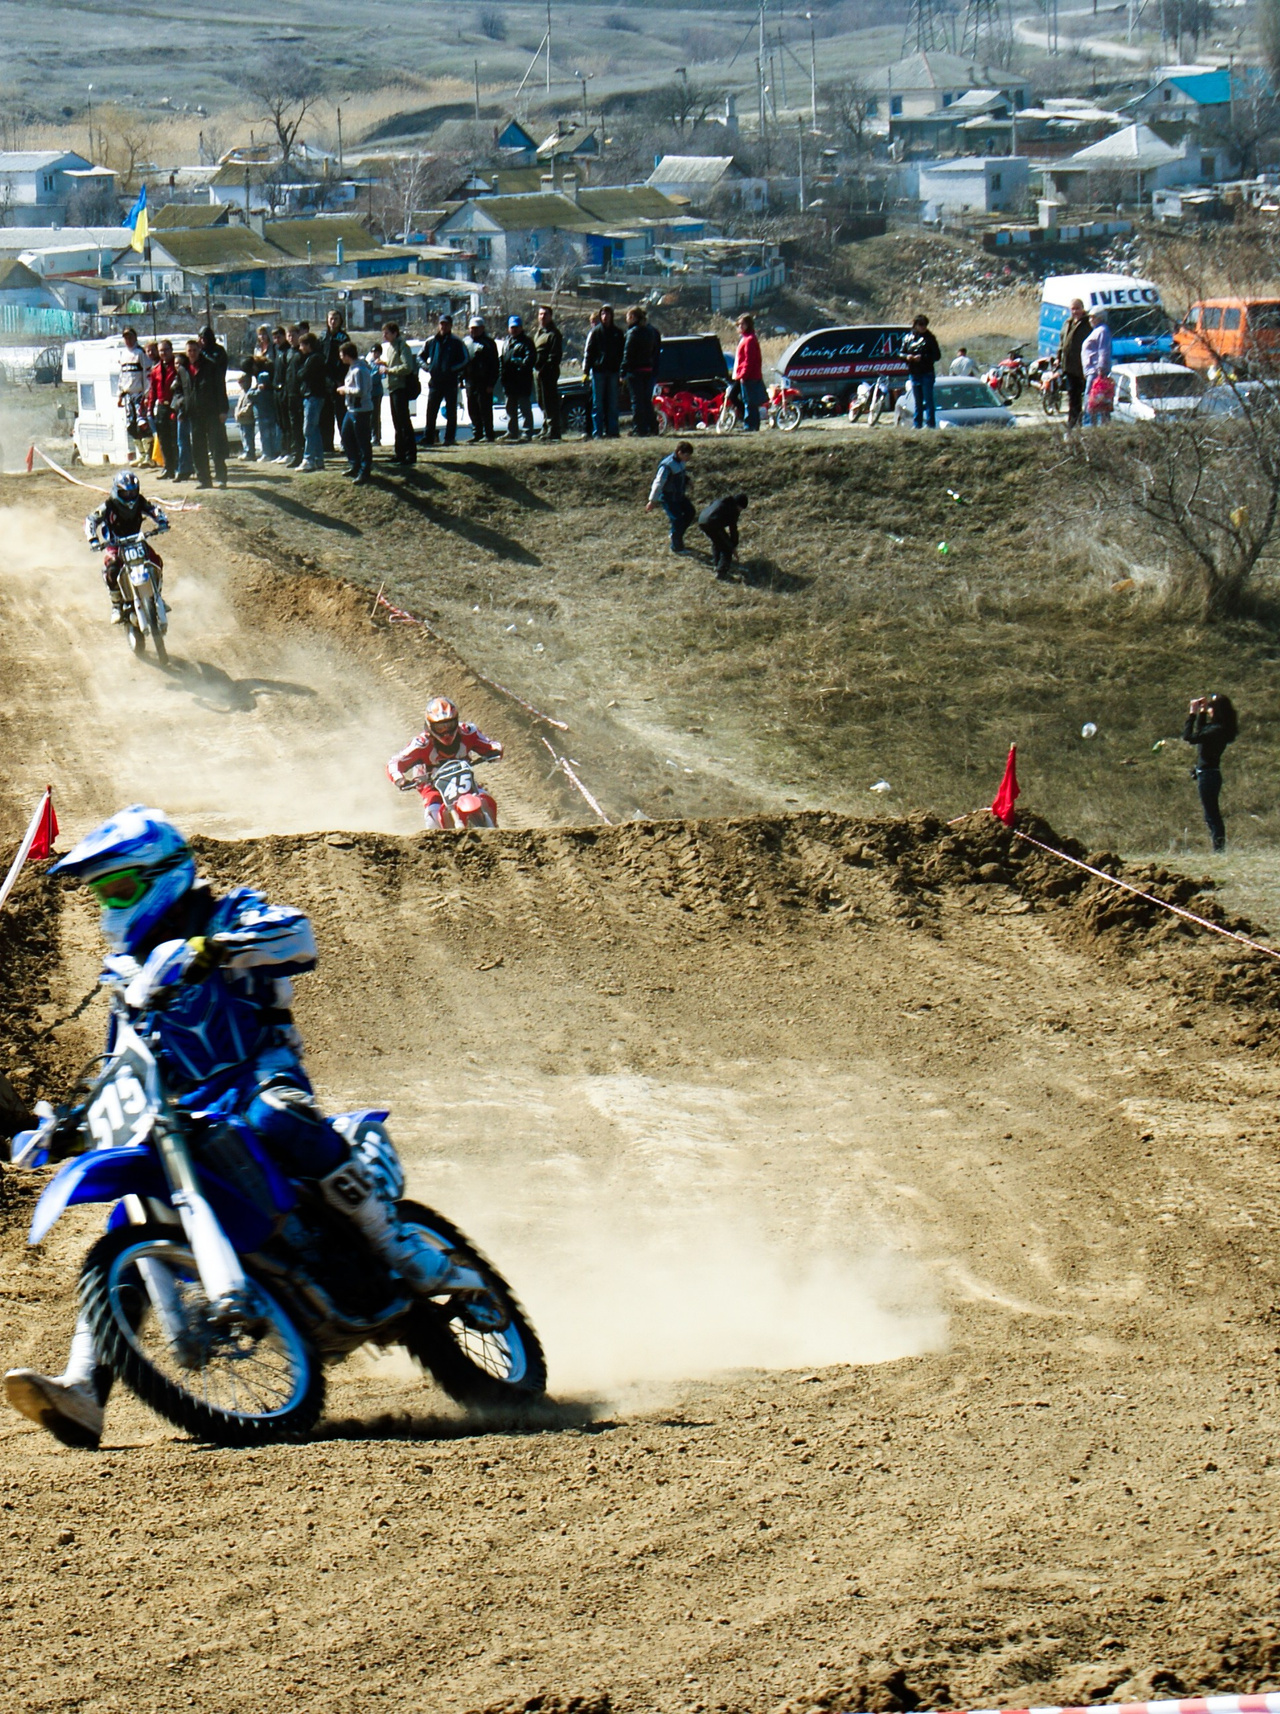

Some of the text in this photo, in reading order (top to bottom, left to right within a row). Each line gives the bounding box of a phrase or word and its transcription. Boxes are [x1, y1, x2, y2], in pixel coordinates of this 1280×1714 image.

[1090, 288, 1160, 306] IVECO
[800, 343, 866, 359] Racing Club
[788, 362, 909, 377] MOTOCROSS VOLGOGRA
[443, 773, 472, 800] 45
